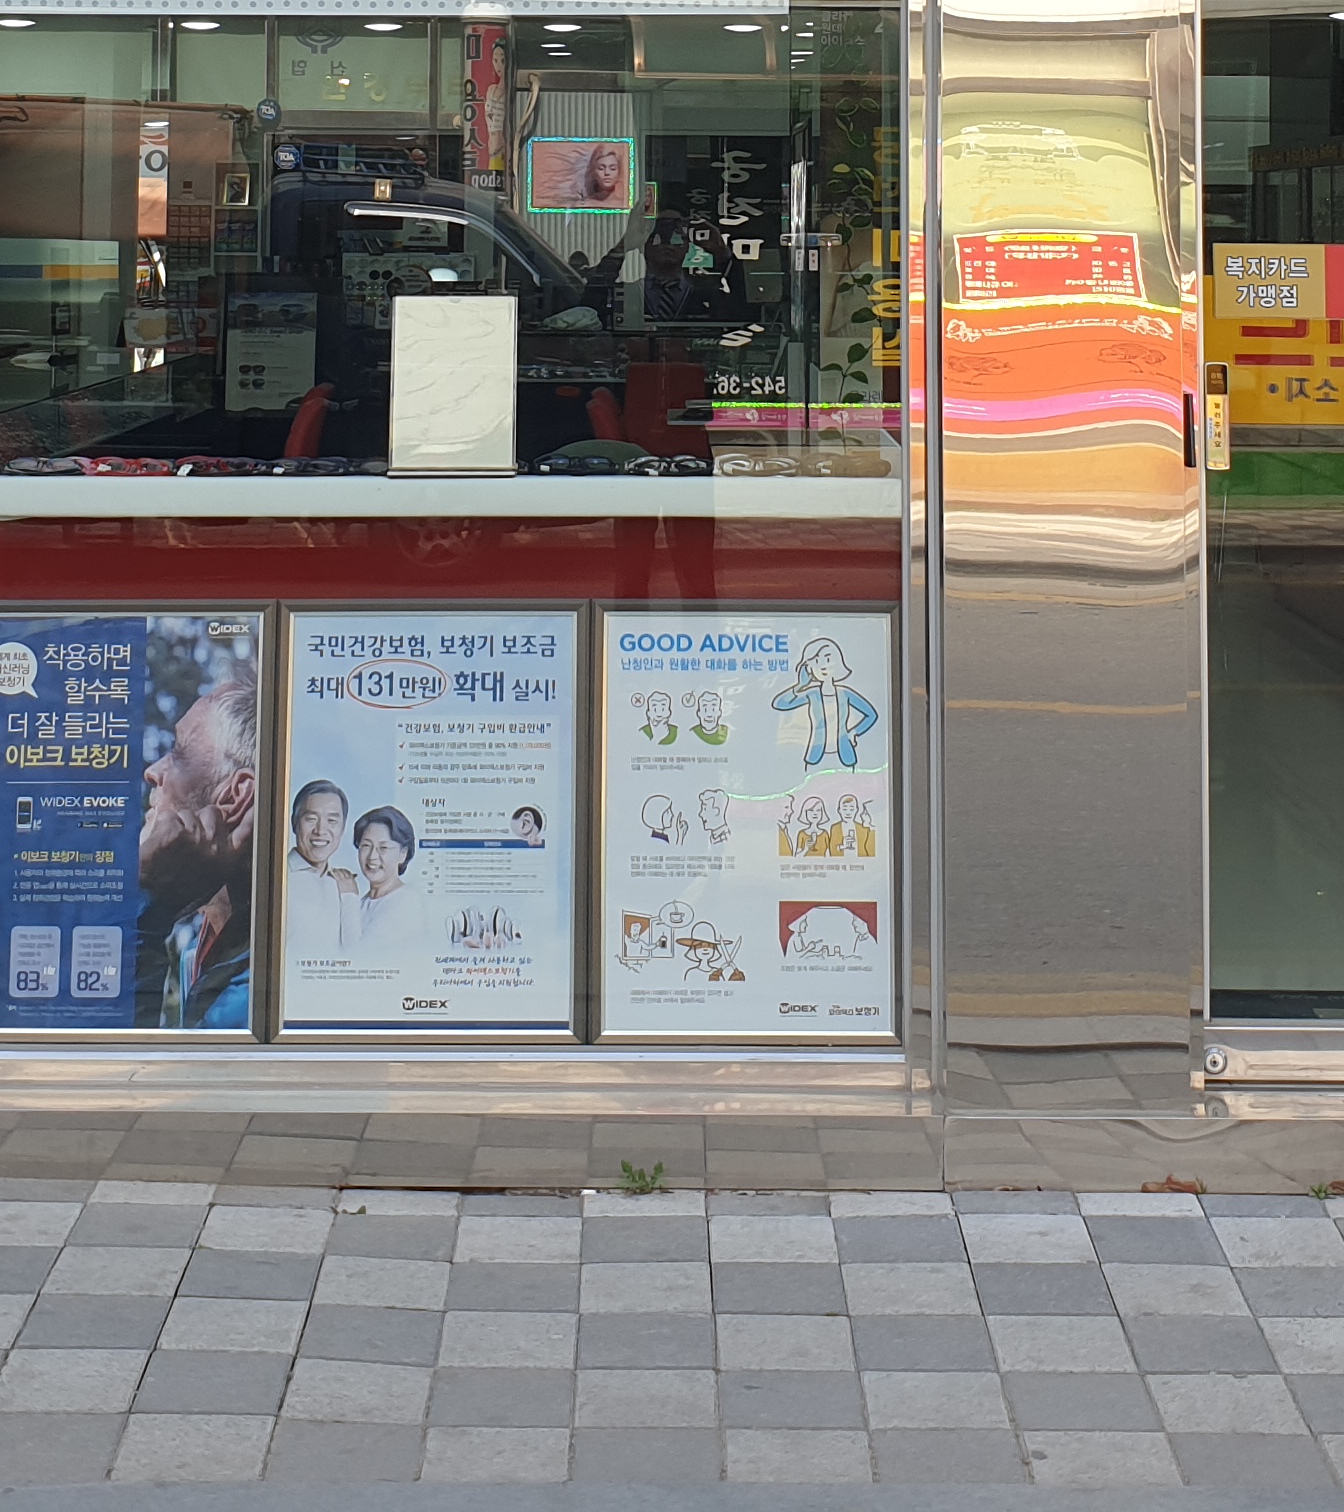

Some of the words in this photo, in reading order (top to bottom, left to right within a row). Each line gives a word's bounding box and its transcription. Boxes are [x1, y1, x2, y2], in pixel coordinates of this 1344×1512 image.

[1223, 254, 1310, 280] 복지카드
[1235, 283, 1300, 309] 가맹점
[207, 621, 251, 636] WIDEX
[306, 634, 432, 659] 국민건강보험,
[439, 634, 495, 658] 보청기
[501, 634, 558, 659] 보조금
[619, 633, 693, 653] GOOD
[699, 633, 789, 653] ADVICE
[42, 642, 132, 671] 착용하면
[620, 657, 664, 671] 난청인과
[668, 657, 701, 672] 원활한
[705, 657, 737, 672] 대화를
[742, 657, 764, 672] 하는
[767, 657, 789, 672] 방법
[64, 677, 132, 705] 할수록
[306, 675, 345, 700] 최대
[352, 670, 443, 700] 131만원!
[452, 670, 505, 702] 확대
[511, 678, 558, 702] 실시!
[7, 711, 28, 739] 더
[34, 711, 59, 739] 잘
[62, 711, 131, 739] 들리는
[446, 722, 475, 734] 보청기
[478, 722, 506, 734] 구입비
[5, 743, 66, 769] 이보크
[68, 743, 129, 769] 보청기
[39, 796, 81, 807] WIDEX
[20, 850, 49, 863] 이보크
[401, 996, 449, 1011] WIDEX
[778, 1002, 818, 1014] WIDEX
